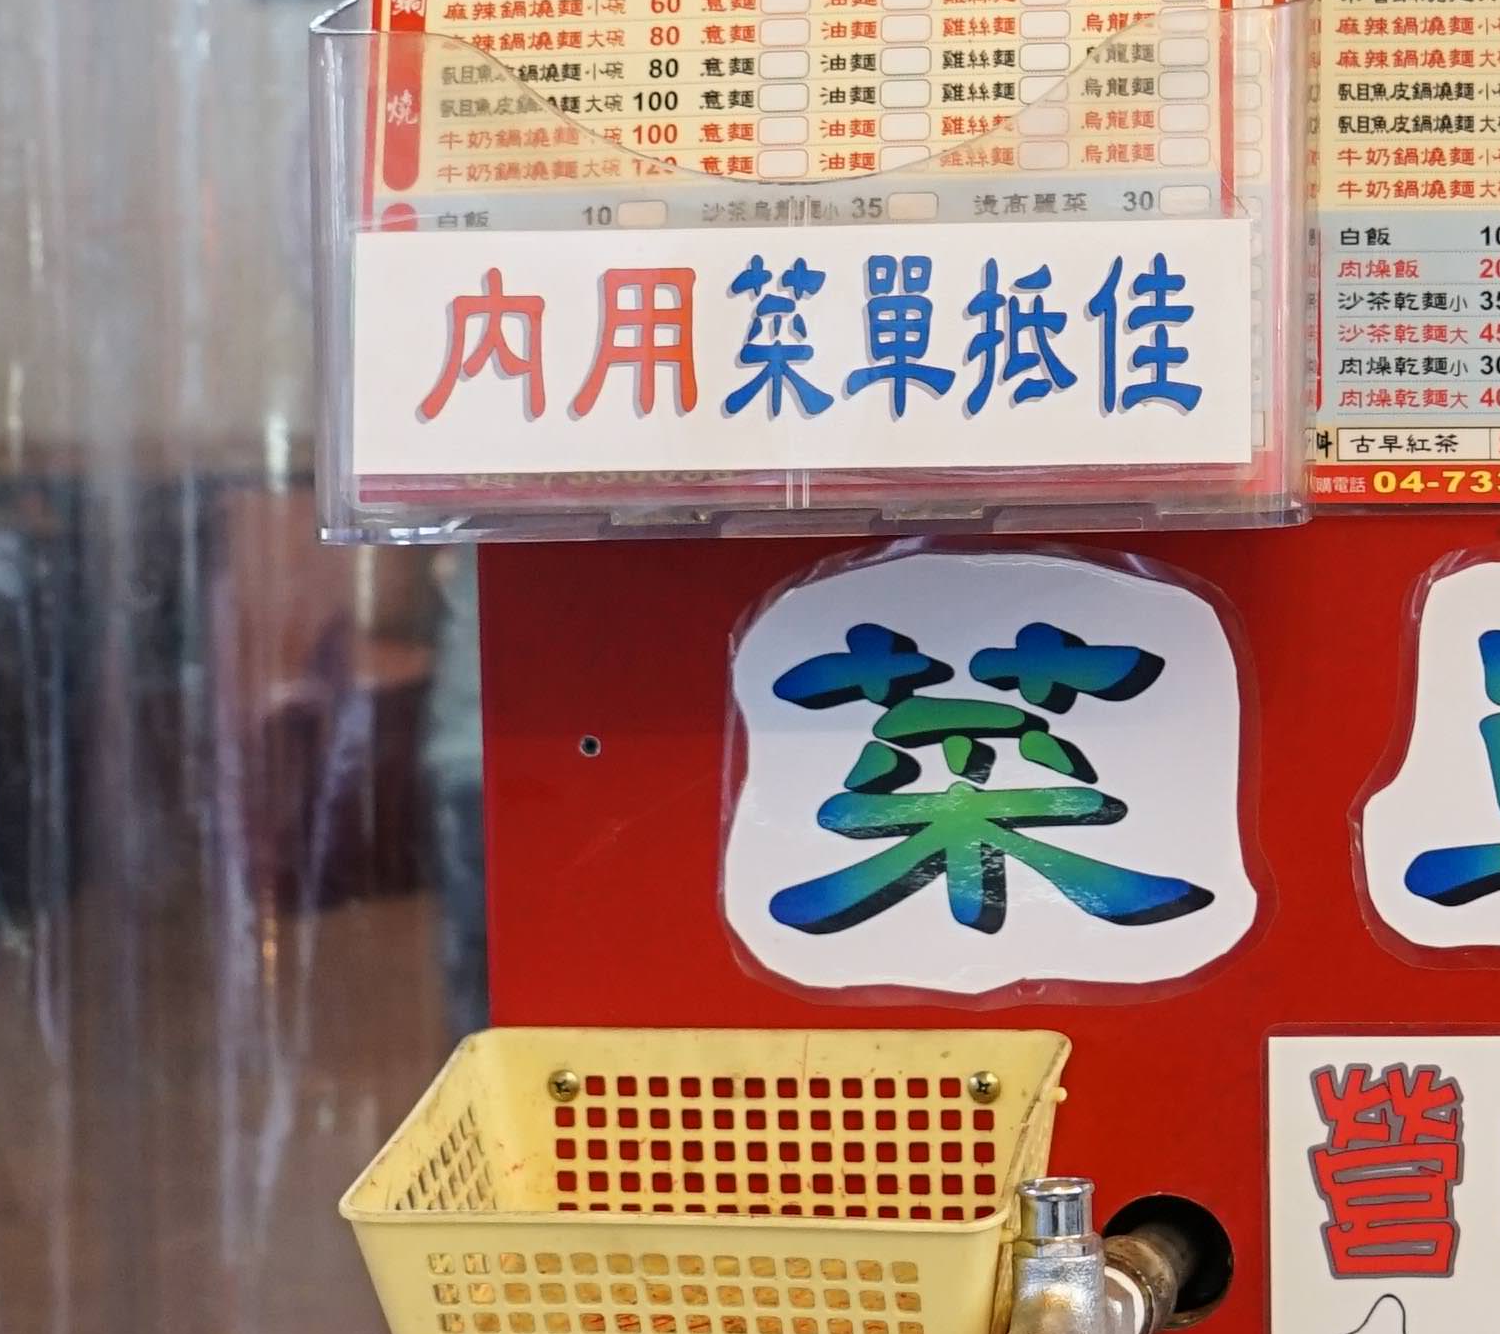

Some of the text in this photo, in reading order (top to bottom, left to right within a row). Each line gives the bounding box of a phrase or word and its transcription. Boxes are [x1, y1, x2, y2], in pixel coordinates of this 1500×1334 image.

[1341, 228, 1391, 245] 白飯
[1338, 292, 1468, 311] 沙茶乾麵小
[1338, 324, 1468, 343] 沙茶乾麵大
[1350, 434, 1459, 454] 古早紅茶
